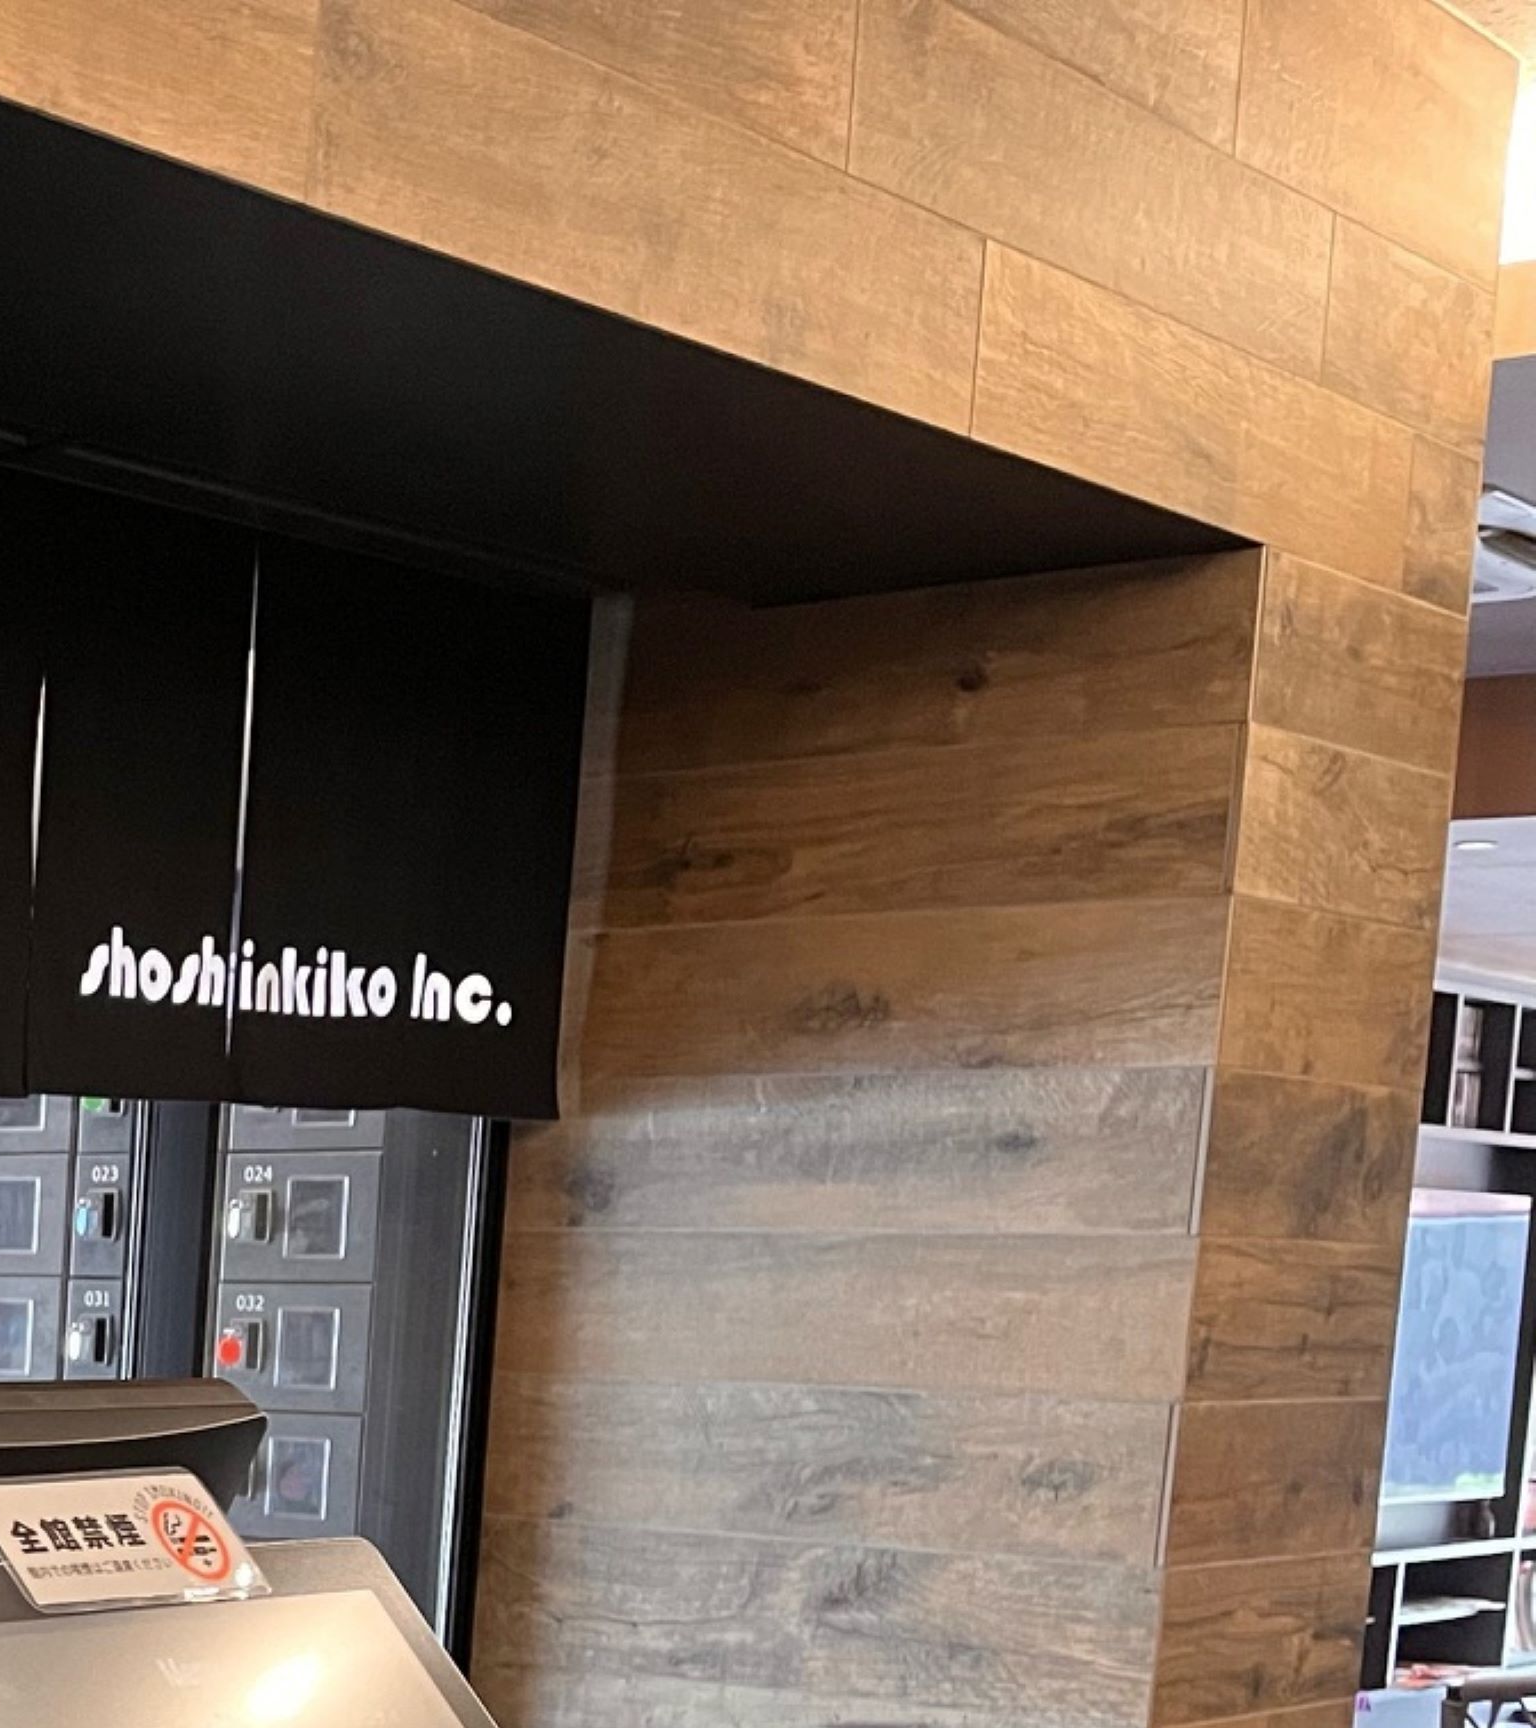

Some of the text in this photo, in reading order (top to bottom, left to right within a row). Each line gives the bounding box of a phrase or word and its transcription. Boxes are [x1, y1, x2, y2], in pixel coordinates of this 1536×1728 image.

[79, 925, 398, 1018] shoshinkiko
[410, 952, 513, 1026] Inc.
[92, 1165, 120, 1183] 023
[243, 1165, 273, 1183] 024
[84, 1290, 110, 1307] 031
[236, 1294, 265, 1312] 032
[10, 1512, 147, 1555] 全館禁煙
